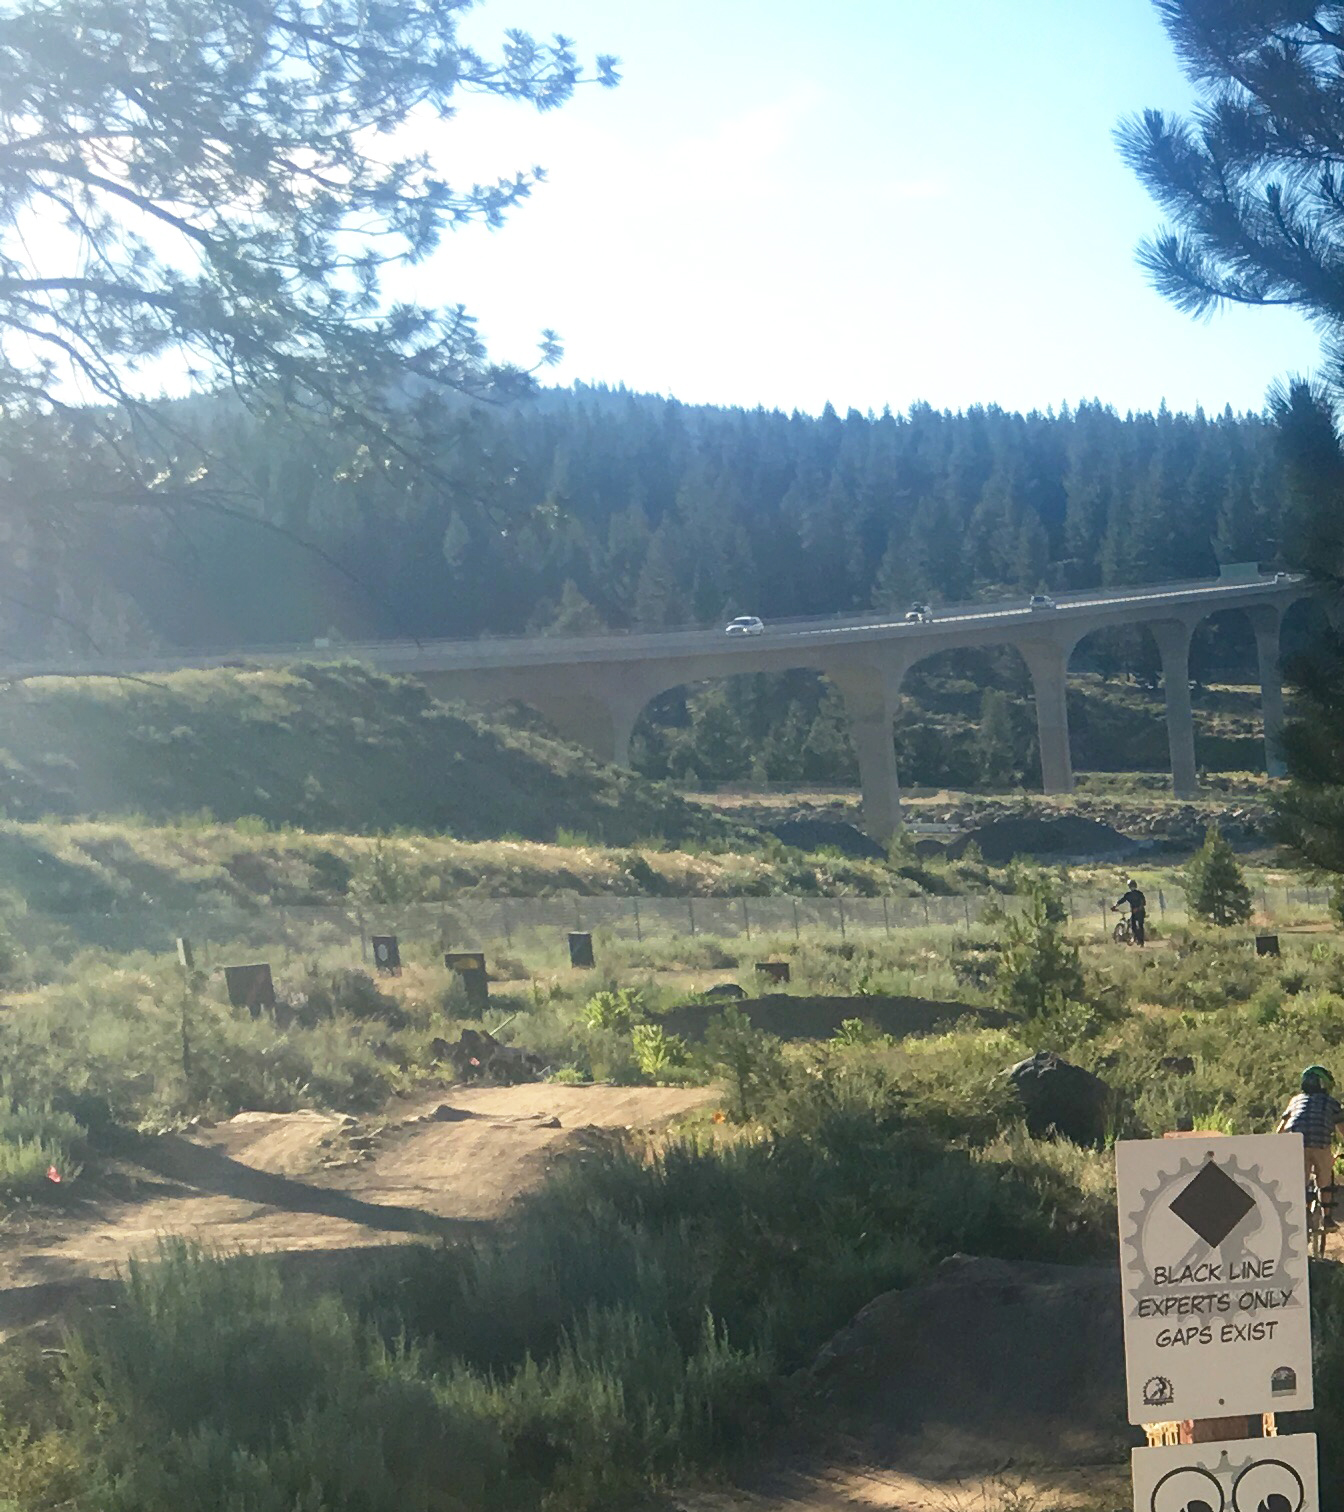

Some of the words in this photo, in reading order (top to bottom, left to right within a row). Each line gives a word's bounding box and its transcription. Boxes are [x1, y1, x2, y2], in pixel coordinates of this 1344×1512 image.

[1153, 1264, 1222, 1286] BLACK
[1229, 1259, 1275, 1281] LINE
[1137, 1293, 1230, 1318] EXPERTS
[1238, 1289, 1293, 1311] ONLY
[1155, 1326, 1212, 1347] GAPS
[1220, 1321, 1279, 1342] EXIST
